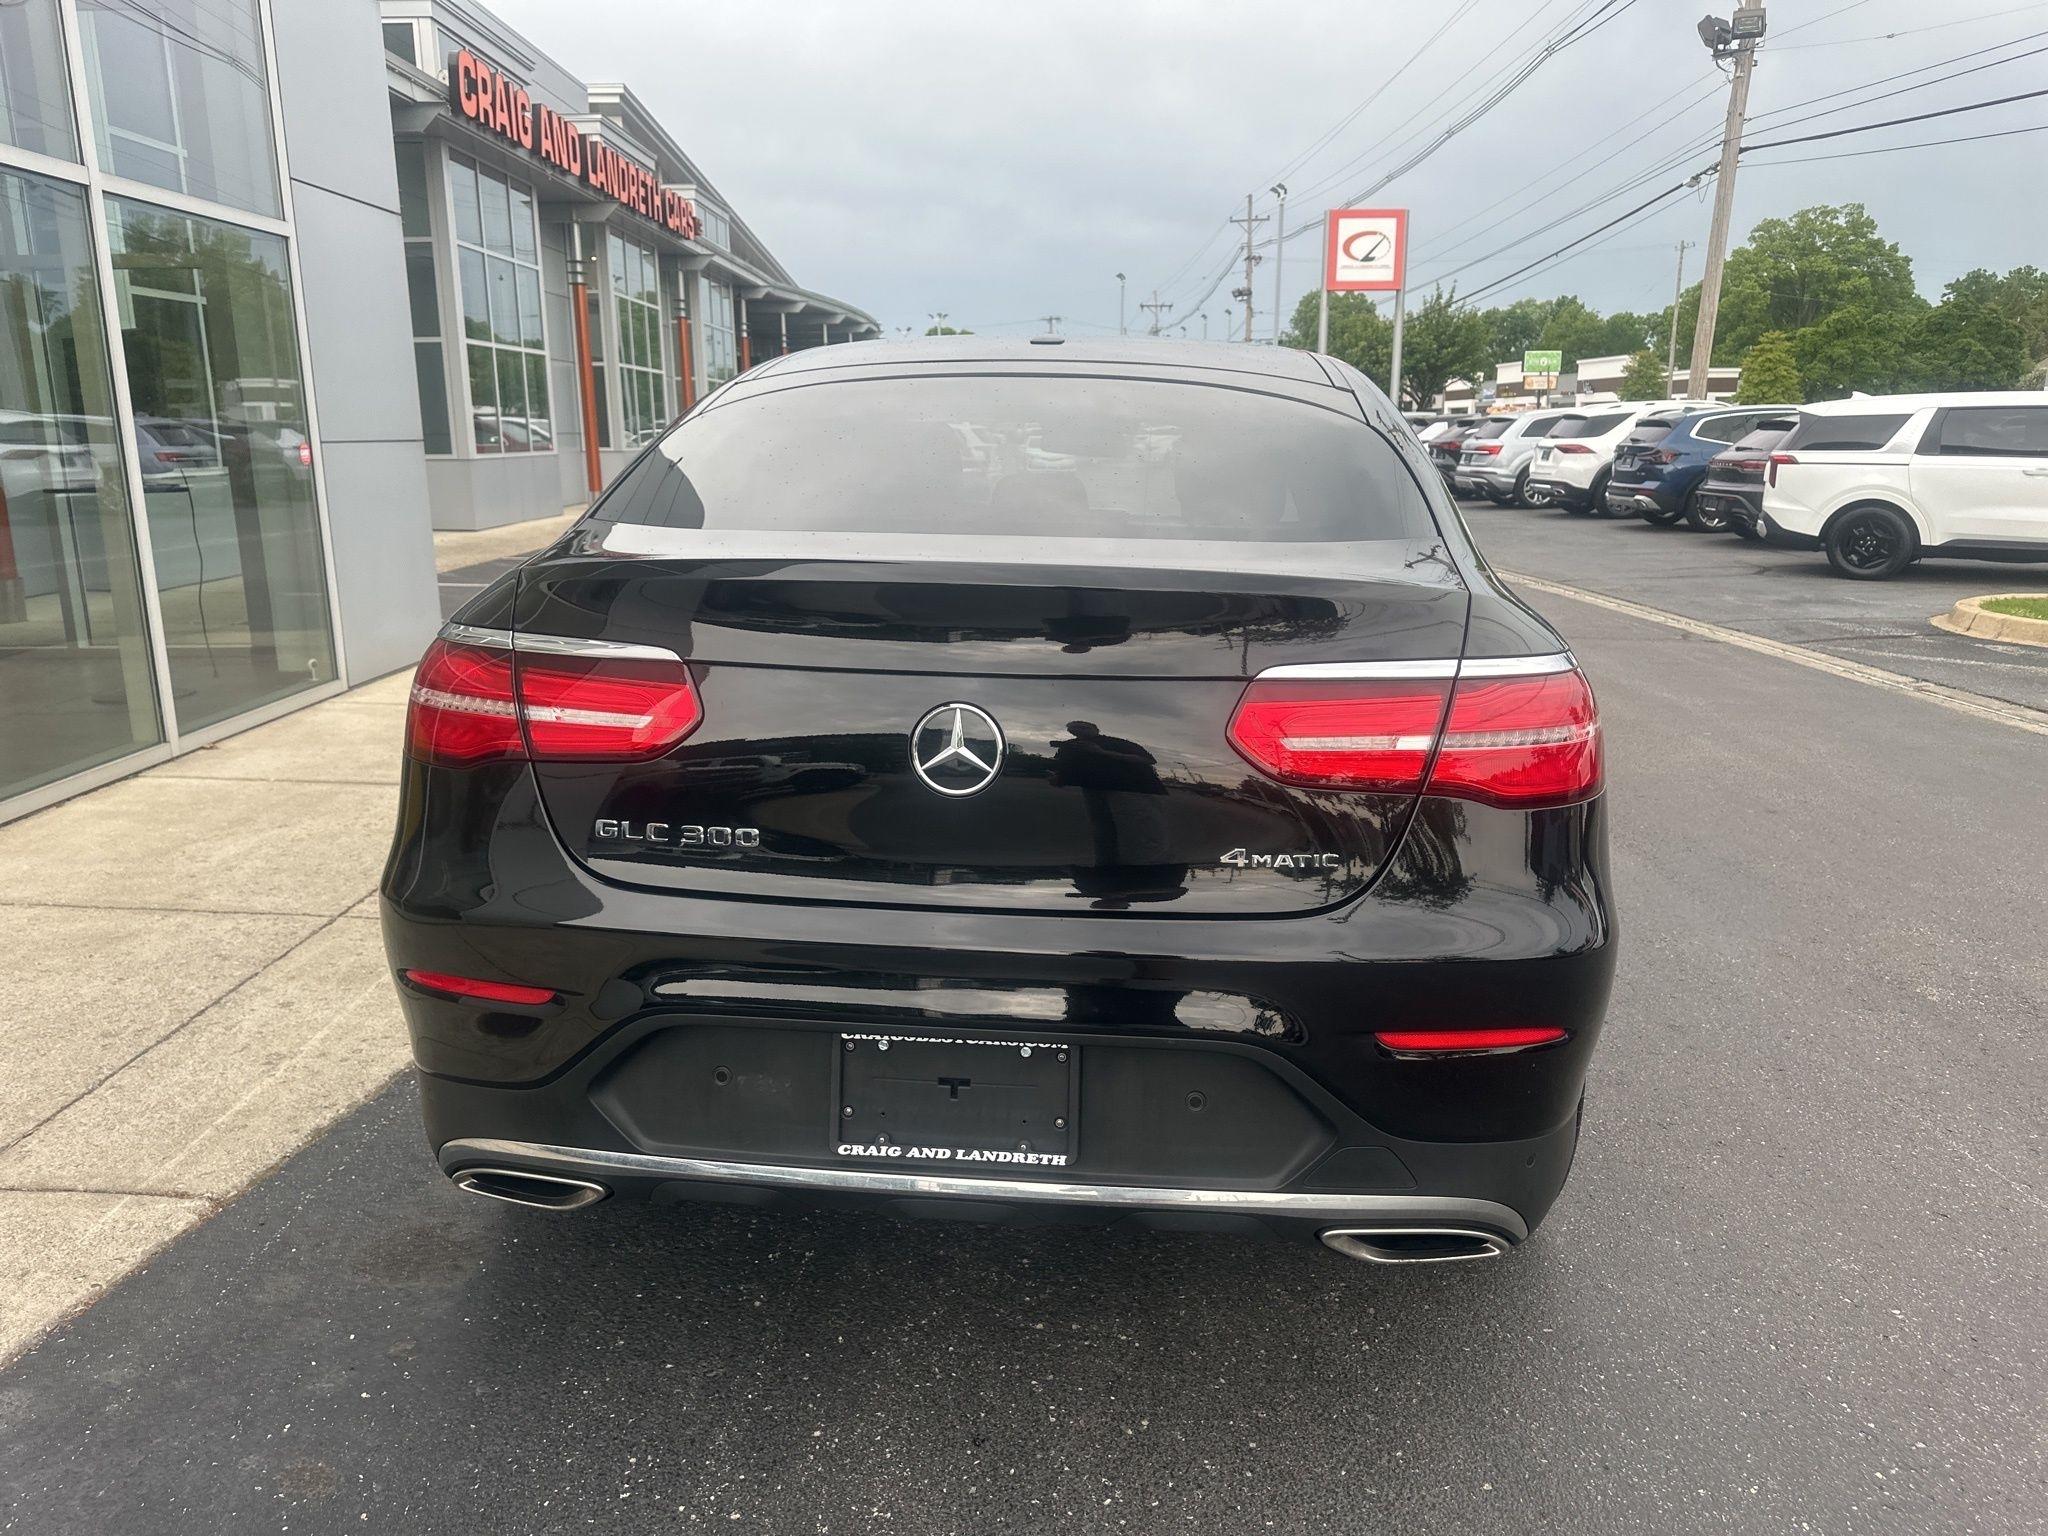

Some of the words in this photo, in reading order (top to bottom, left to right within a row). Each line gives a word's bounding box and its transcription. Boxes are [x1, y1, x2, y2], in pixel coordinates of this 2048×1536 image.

[457, 48, 533, 150] CRAIG
[540, 104, 581, 177] AND
[586, 134, 663, 224] LANDRETH
[665, 187, 696, 241] CARS
[595, 819, 669, 842] GLC
[680, 825, 760, 847] 300
[1220, 848, 1340, 868] 4MATIC
[837, 1144, 902, 1157] CRAIG
[905, 1147, 951, 1159] AND
[955, 1149, 1068, 1166] LANDRETH
